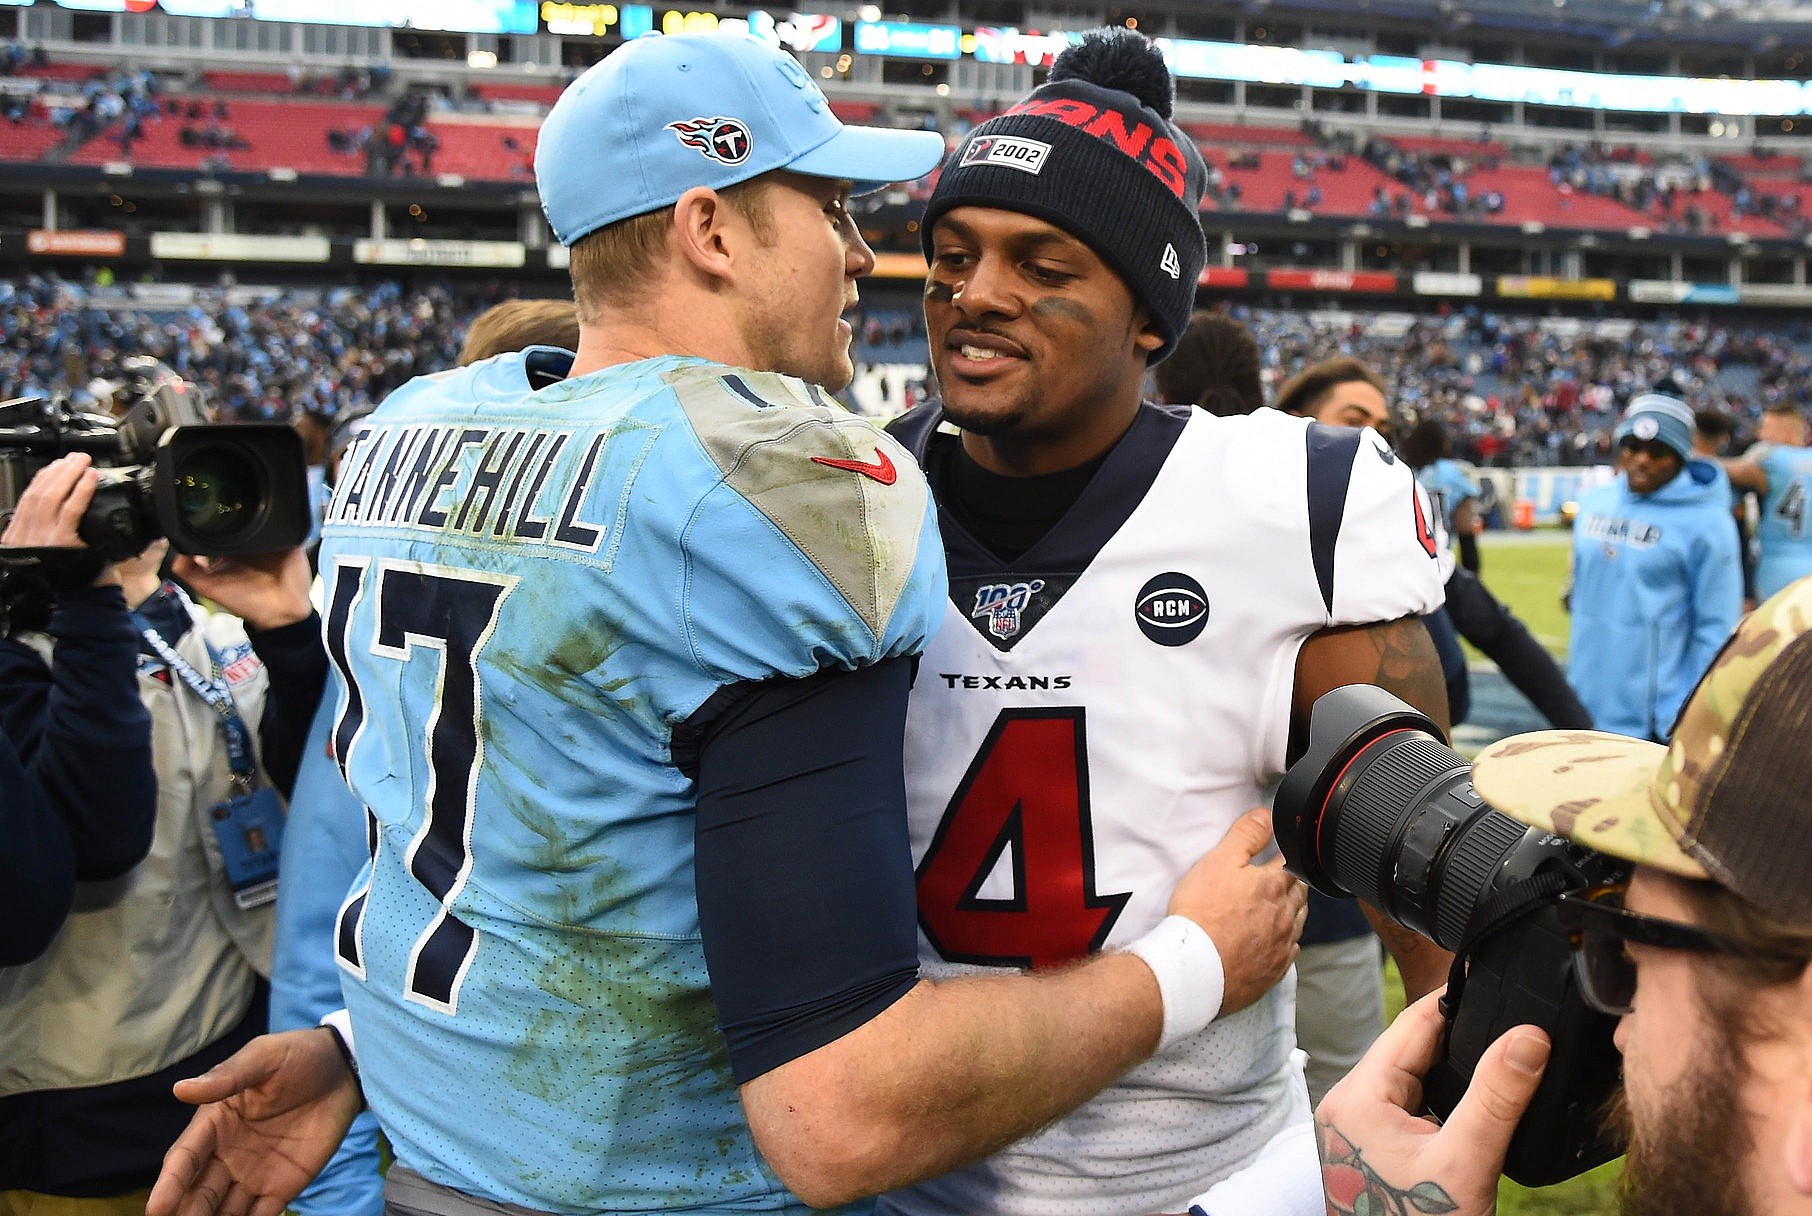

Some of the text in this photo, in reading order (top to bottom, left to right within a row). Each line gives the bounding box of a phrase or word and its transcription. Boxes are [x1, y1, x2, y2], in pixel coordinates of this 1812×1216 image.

[993, 144, 1041, 164] 2002
[324, 424, 612, 553] TANNEHILL
[1153, 599, 1190, 617] RCM
[940, 673, 1072, 690] TEXANS
[322, 555, 522, 1017] 17
[915, 706, 1132, 972] 4
